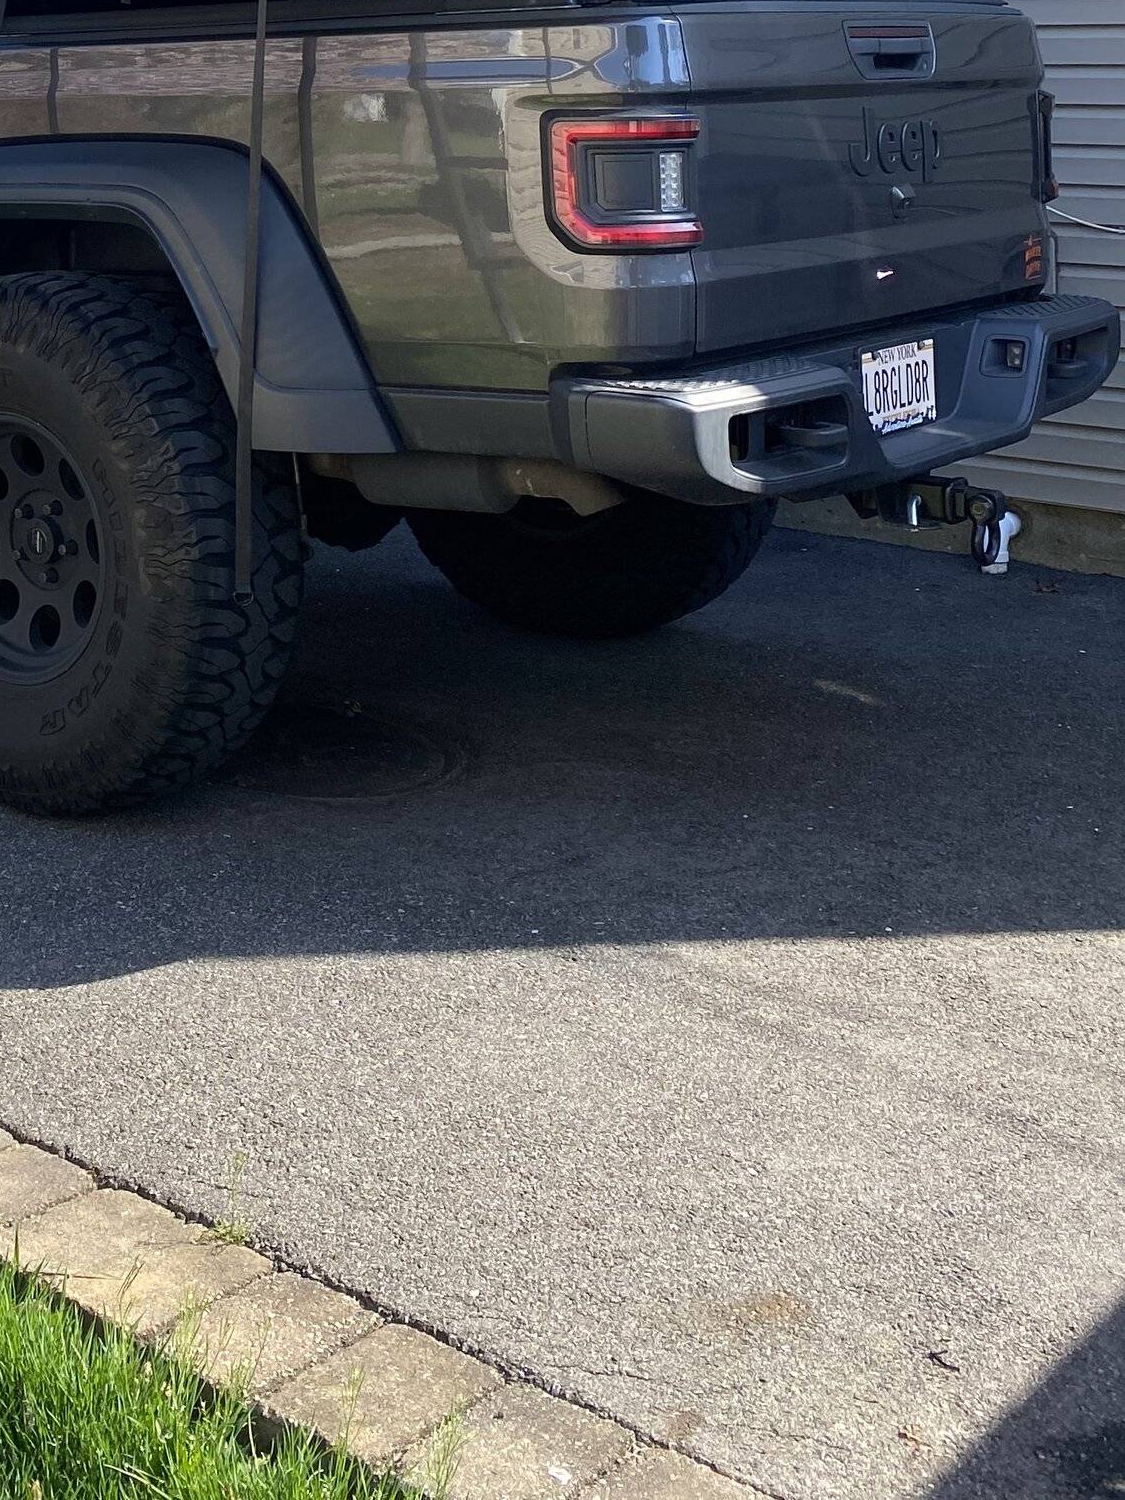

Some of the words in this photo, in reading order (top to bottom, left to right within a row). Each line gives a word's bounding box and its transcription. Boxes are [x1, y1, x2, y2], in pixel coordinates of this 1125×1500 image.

[848, 106, 940, 183] Jeep
[878, 349, 896, 366] NEW
[897, 343, 917, 361] YORK
[865, 359, 929, 416] L8RGLD8R
